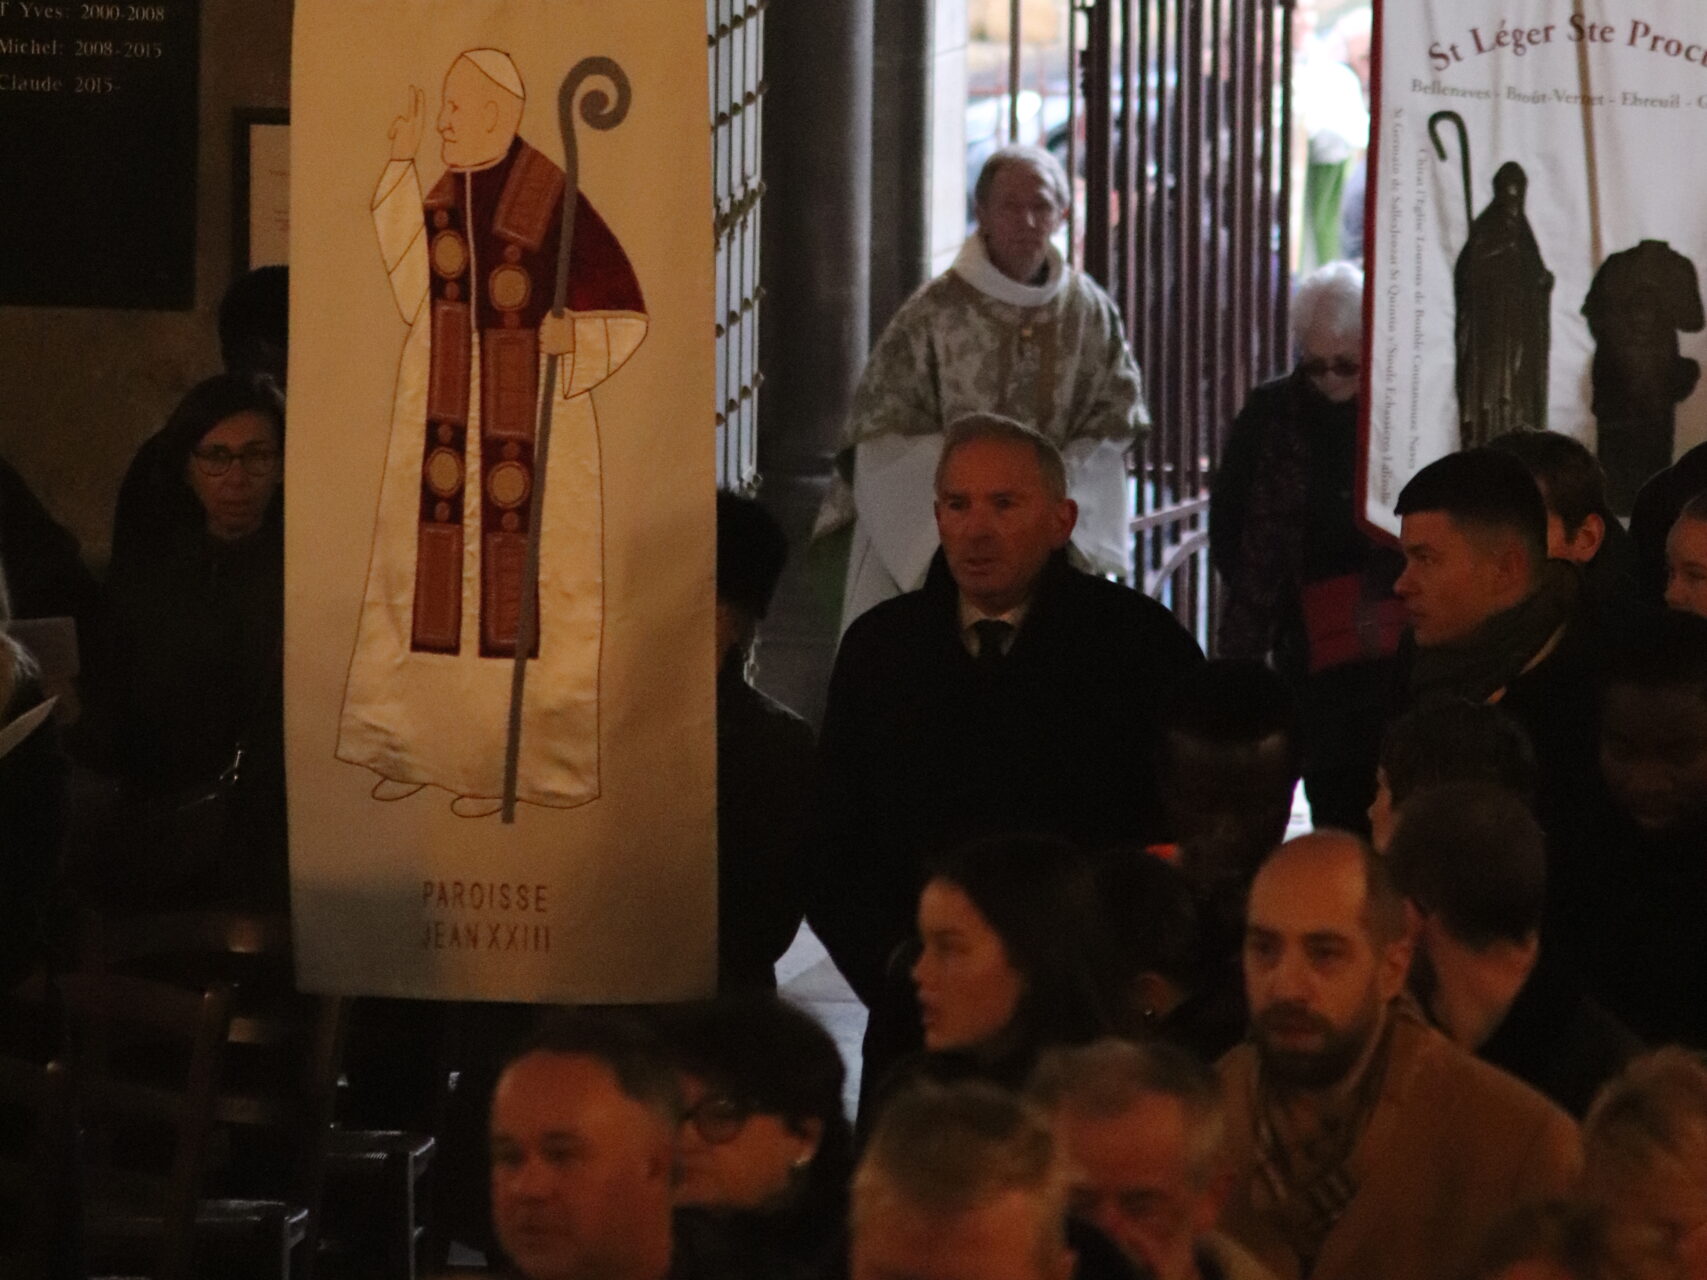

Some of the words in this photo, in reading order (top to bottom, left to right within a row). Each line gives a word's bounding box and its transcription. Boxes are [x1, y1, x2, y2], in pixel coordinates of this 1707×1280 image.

[1428, 42, 1464, 72] St
[1469, 20, 1556, 57] Léger
[1567, 14, 1616, 44] Ste
[422, 882, 548, 913] PAROISSE
[422, 921, 479, 951] JEAN
[487, 922, 549, 954] XXIII
